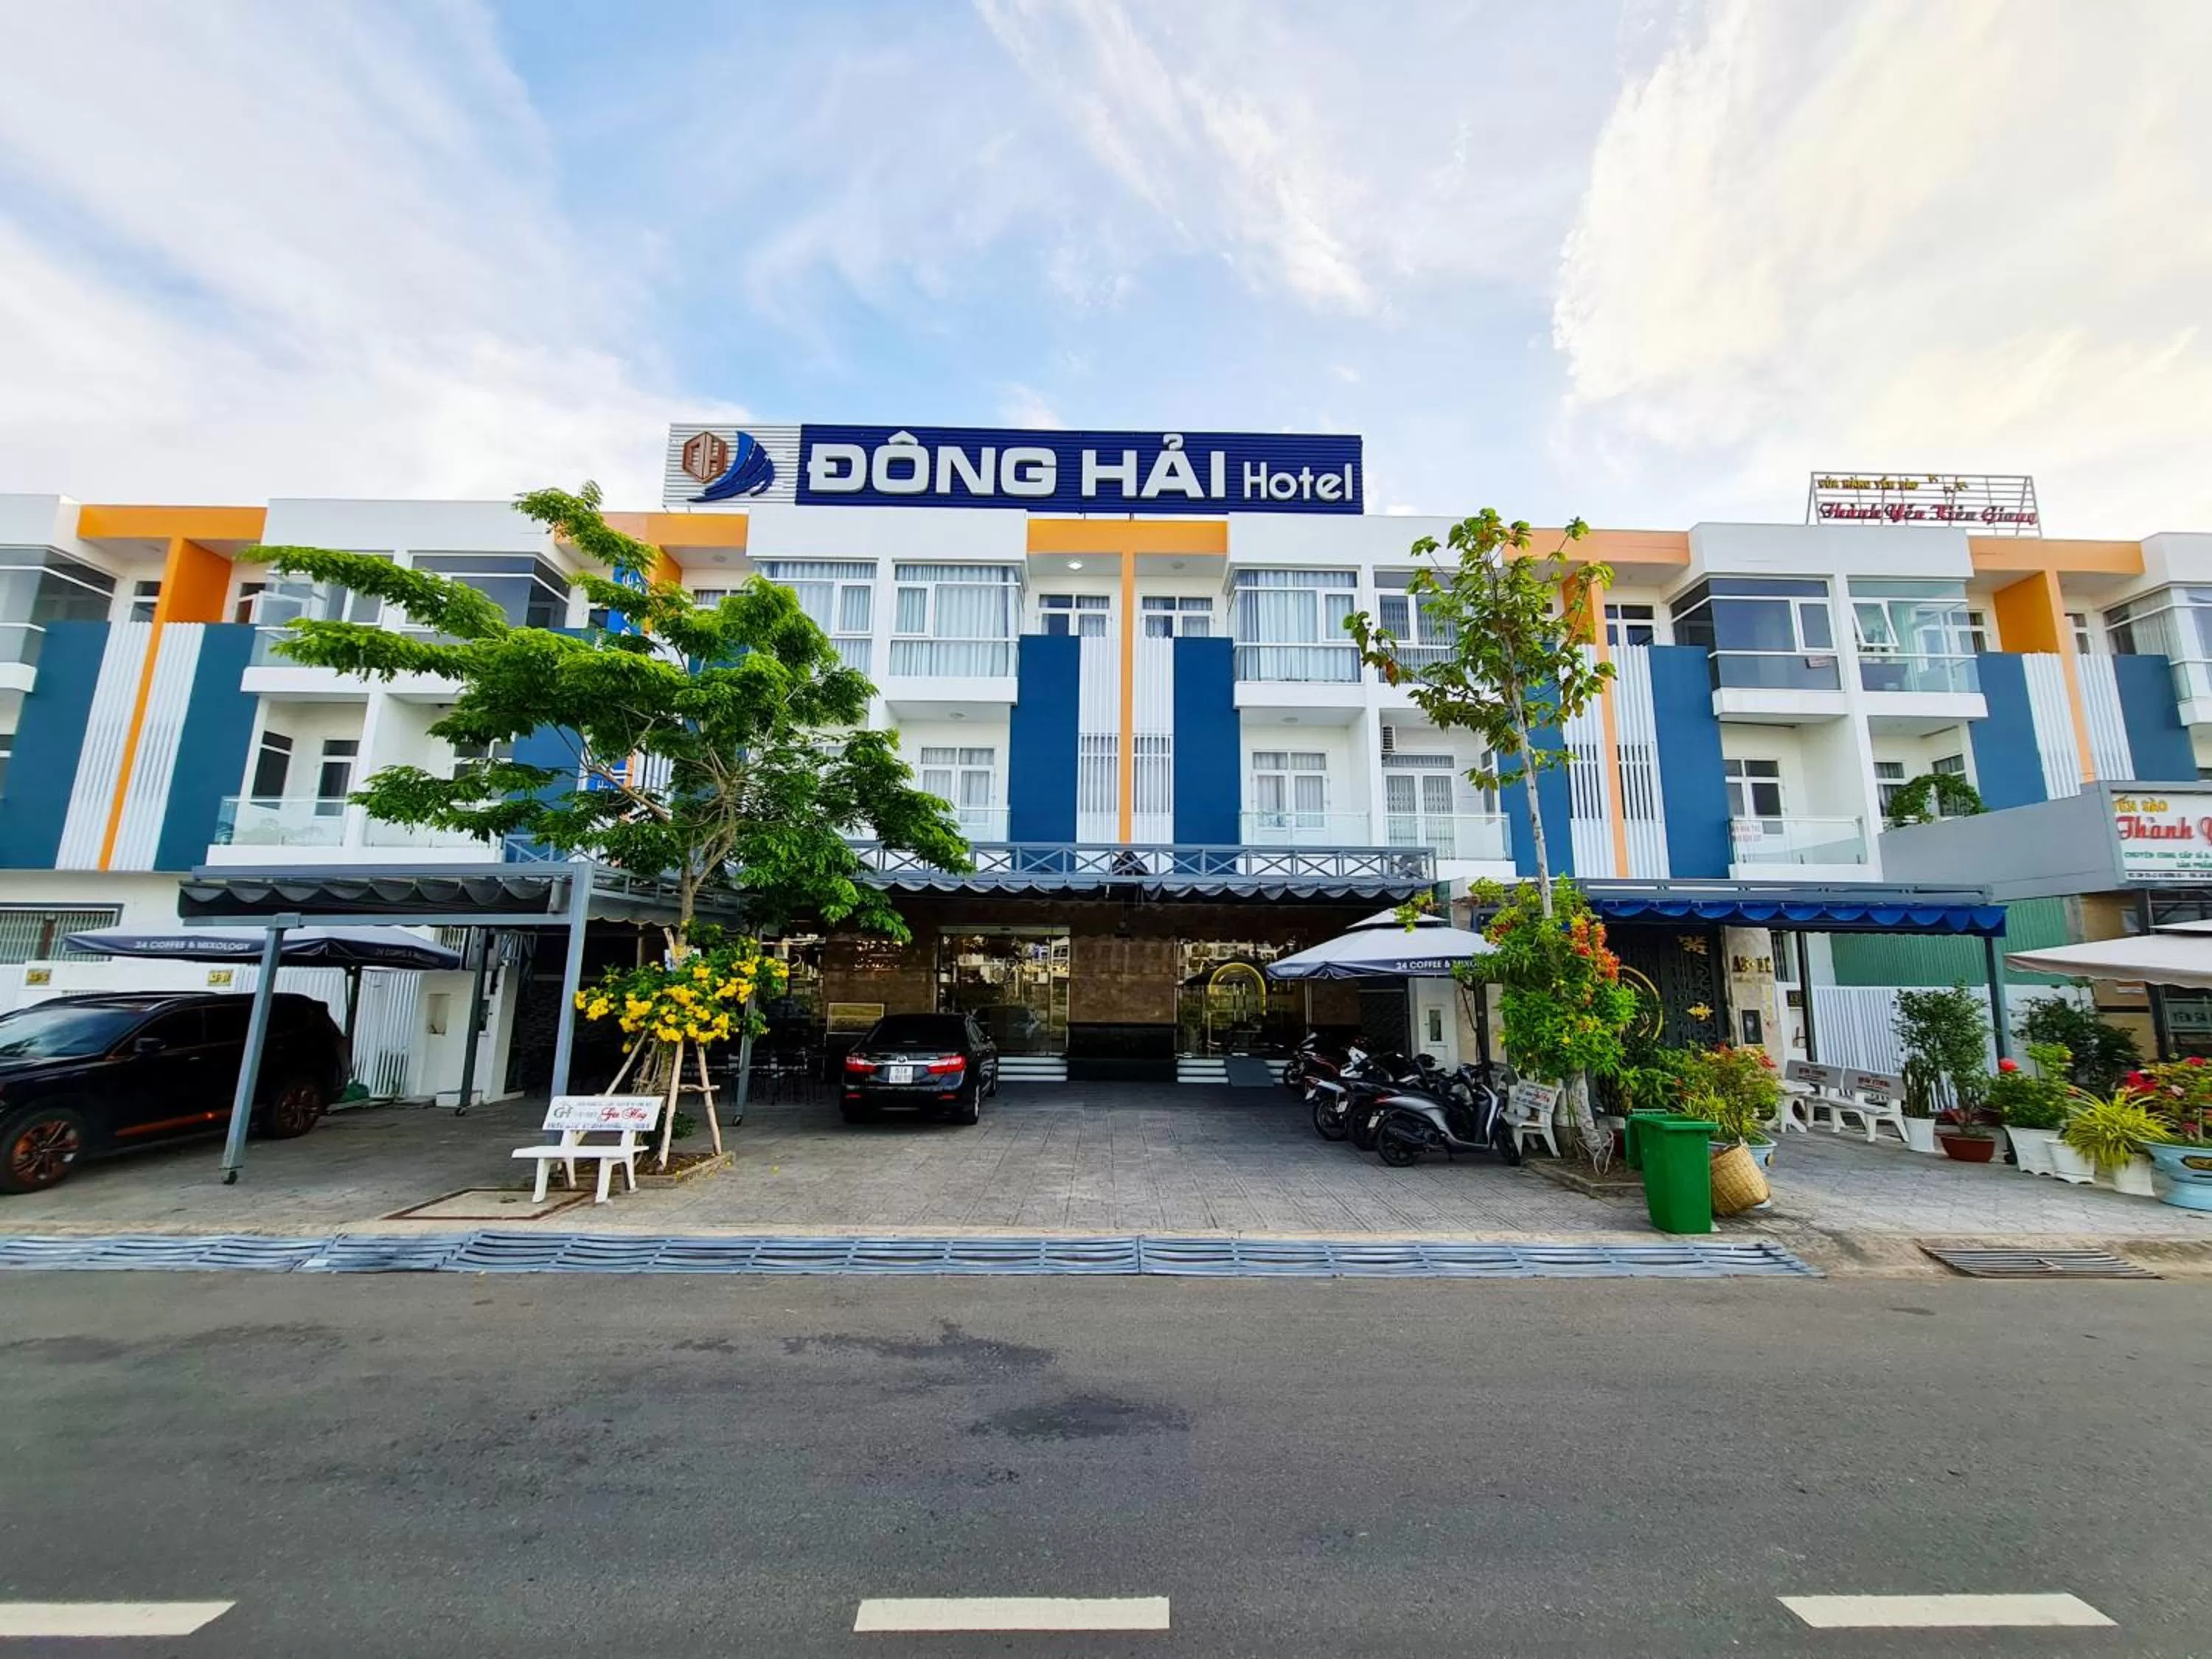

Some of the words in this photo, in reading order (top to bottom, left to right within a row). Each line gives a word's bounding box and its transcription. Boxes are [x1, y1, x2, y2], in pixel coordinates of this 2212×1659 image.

[807, 430, 1057, 498] ĐÔNG
[1081, 433, 1225, 498] HẢI
[1243, 461, 1353, 501] Hotel
[2116, 815, 2194, 840] Thành
[150, 940, 186, 949] COFFEE
[1396, 961, 1408, 970] 24
[1409, 961, 1441, 970] COFFEE
